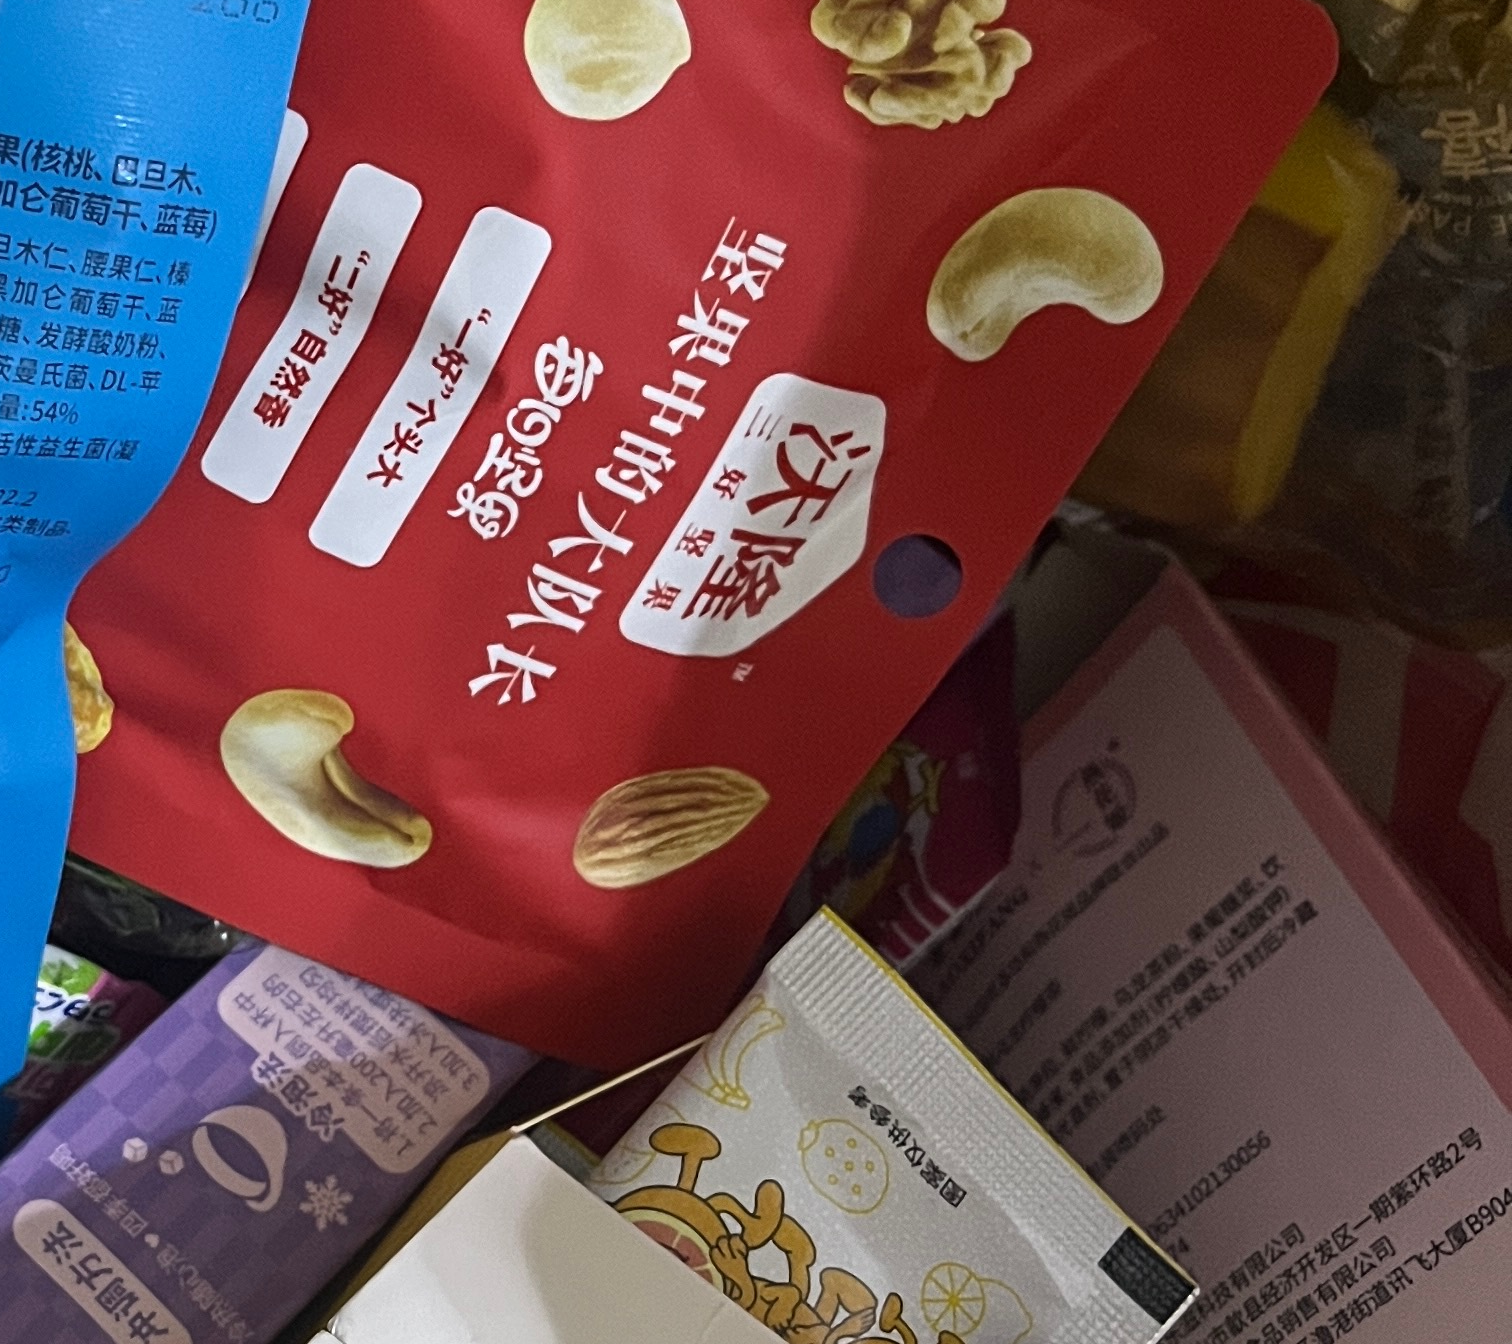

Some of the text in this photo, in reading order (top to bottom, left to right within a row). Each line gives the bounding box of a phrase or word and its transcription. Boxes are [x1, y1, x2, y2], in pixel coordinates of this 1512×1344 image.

[467, 214, 788, 705] 坚果中的大队长
[644, 404, 781, 612] 三好坚果
[684, 418, 873, 622] 沃隆
[255, 1050, 345, 1143] 冷泡法
[846, 1085, 968, 1210] 图案仅供参考
